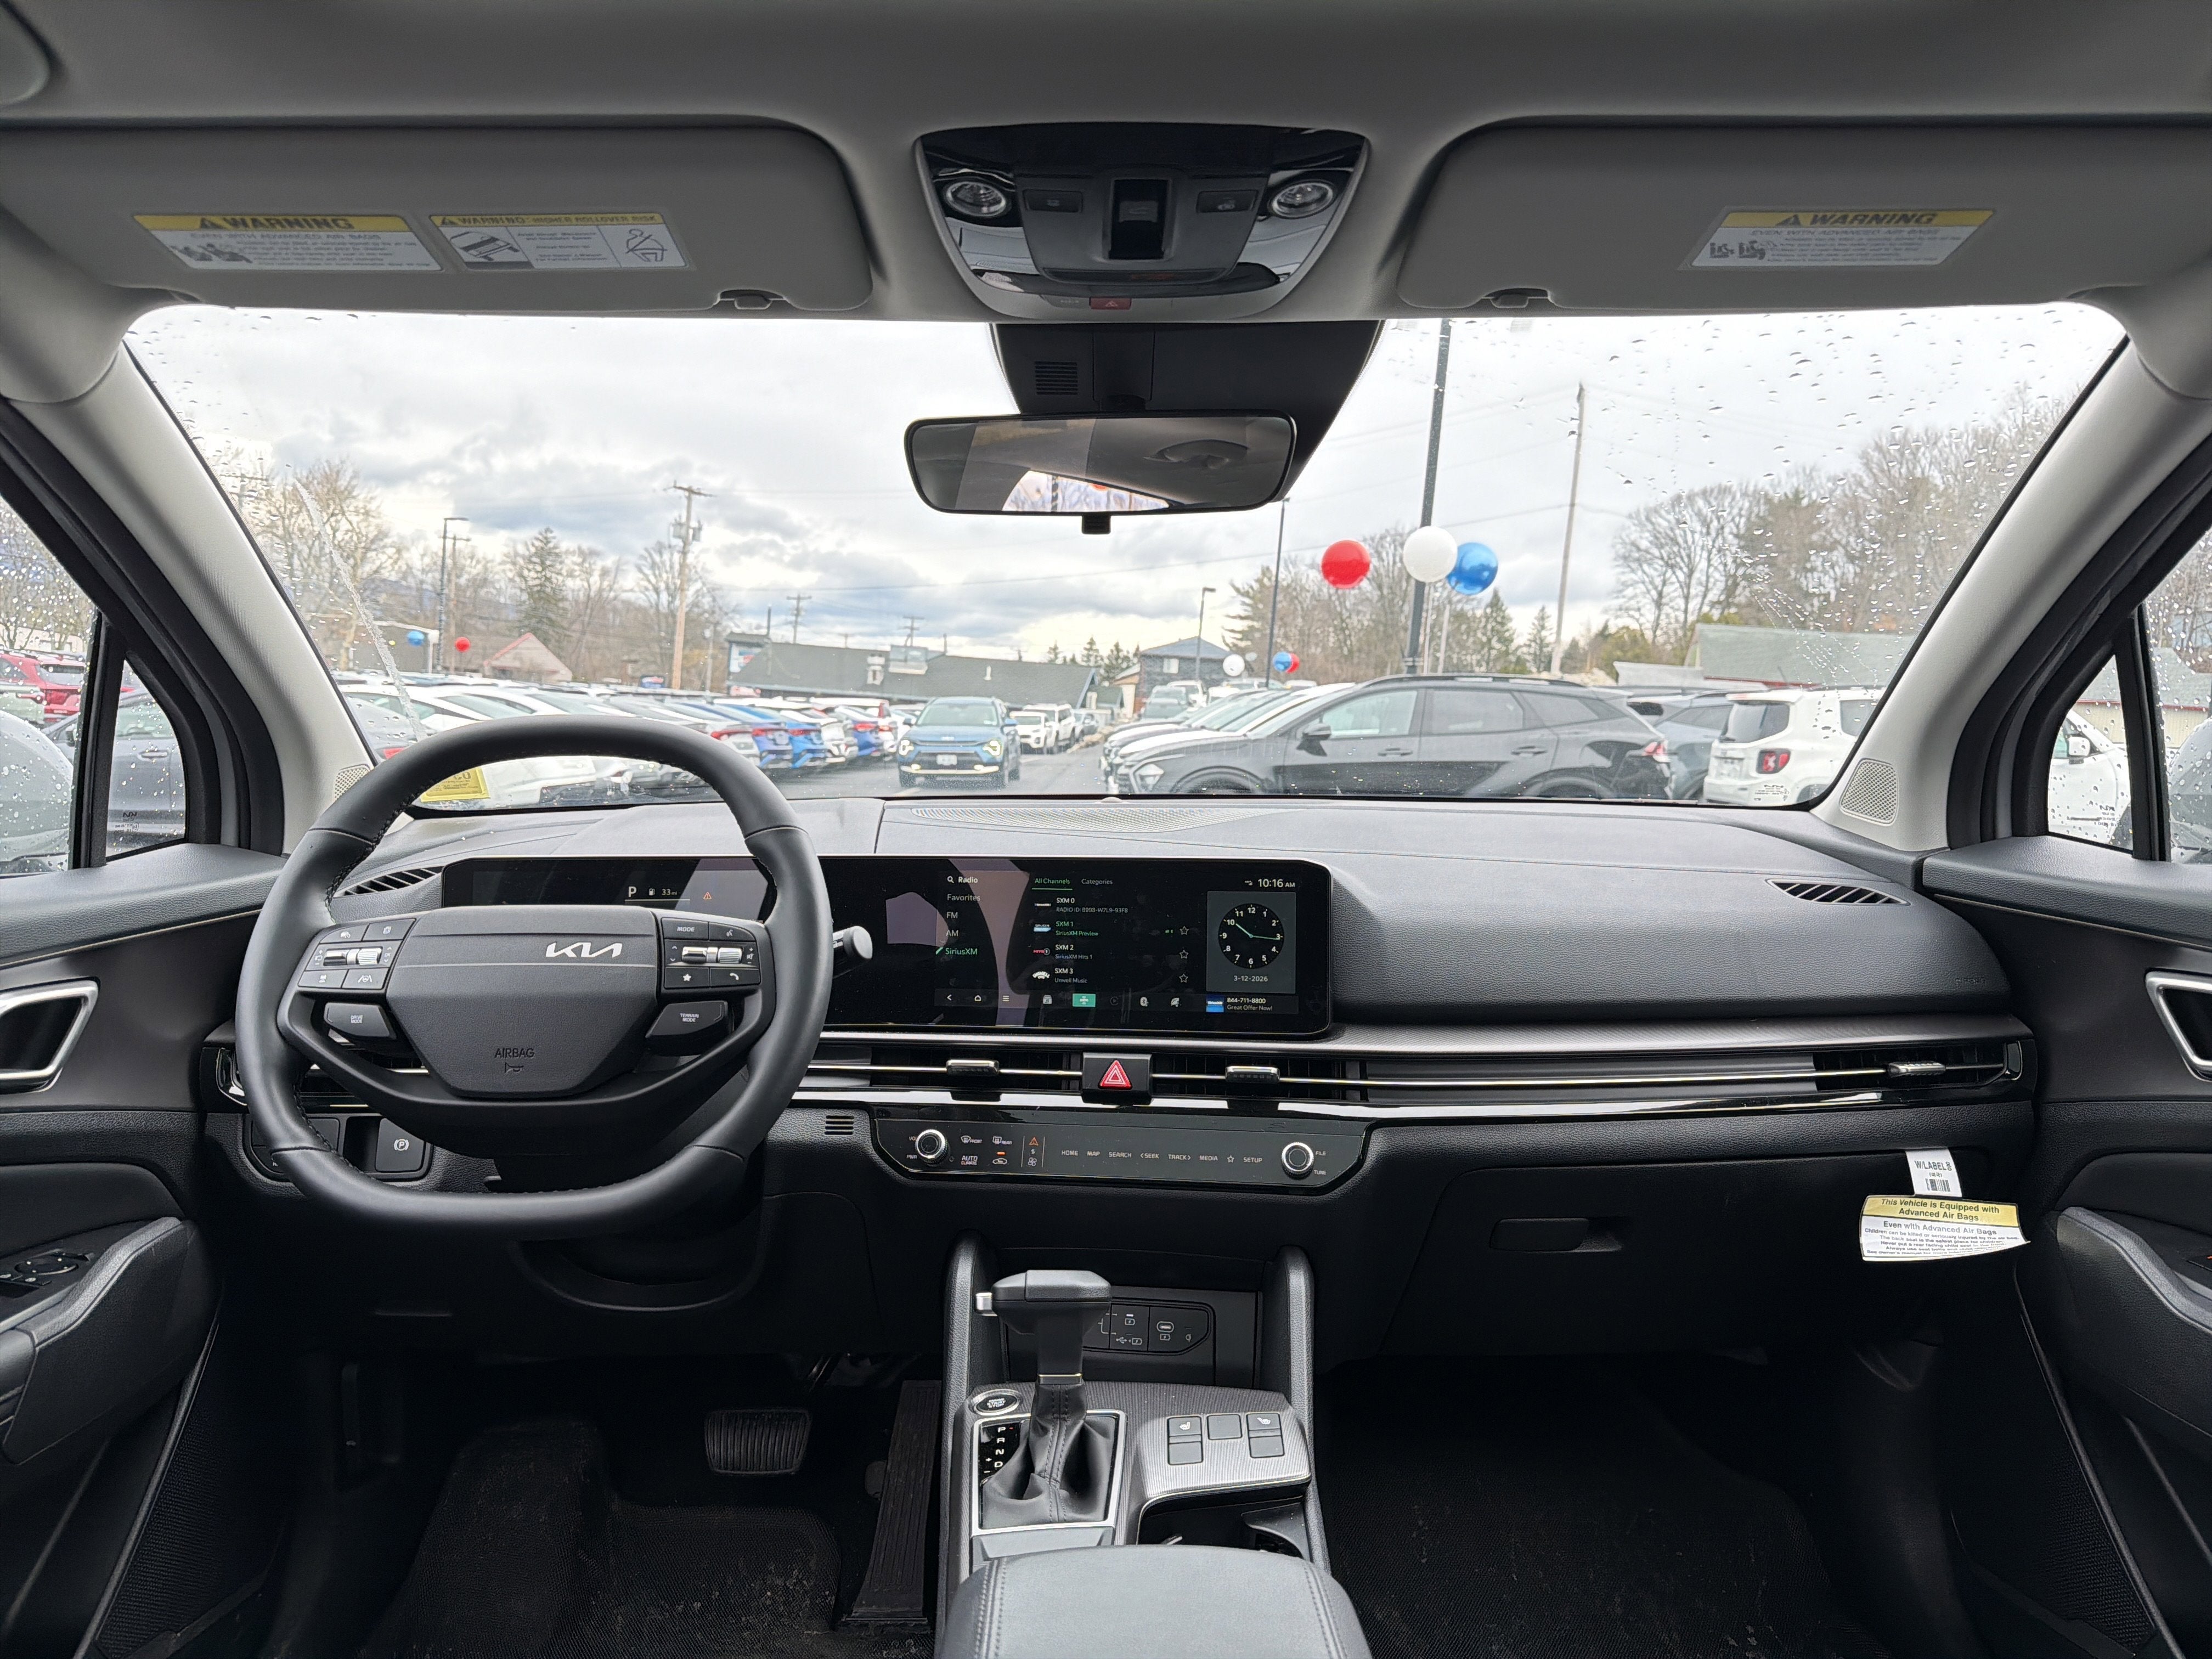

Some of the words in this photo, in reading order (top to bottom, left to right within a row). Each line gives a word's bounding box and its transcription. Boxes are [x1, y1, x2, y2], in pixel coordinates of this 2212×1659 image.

[222, 217, 355, 229] WARNING
[1810, 213, 1938, 225] WARNING
[1257, 879, 1283, 888] 10:16
[628, 887, 636, 897] P
[545, 941, 623, 958] KIA
[495, 1048, 535, 1058] AIRBAG
[1899, 1199, 1928, 1207] Vehicle
[1939, 1201, 1979, 1212] Equipped
[1899, 1208, 1940, 1217] Advanced
[1957, 1213, 1979, 1222] Bags
[1883, 1221, 1902, 1229] Even
[1922, 1224, 1961, 1233] Advanced
